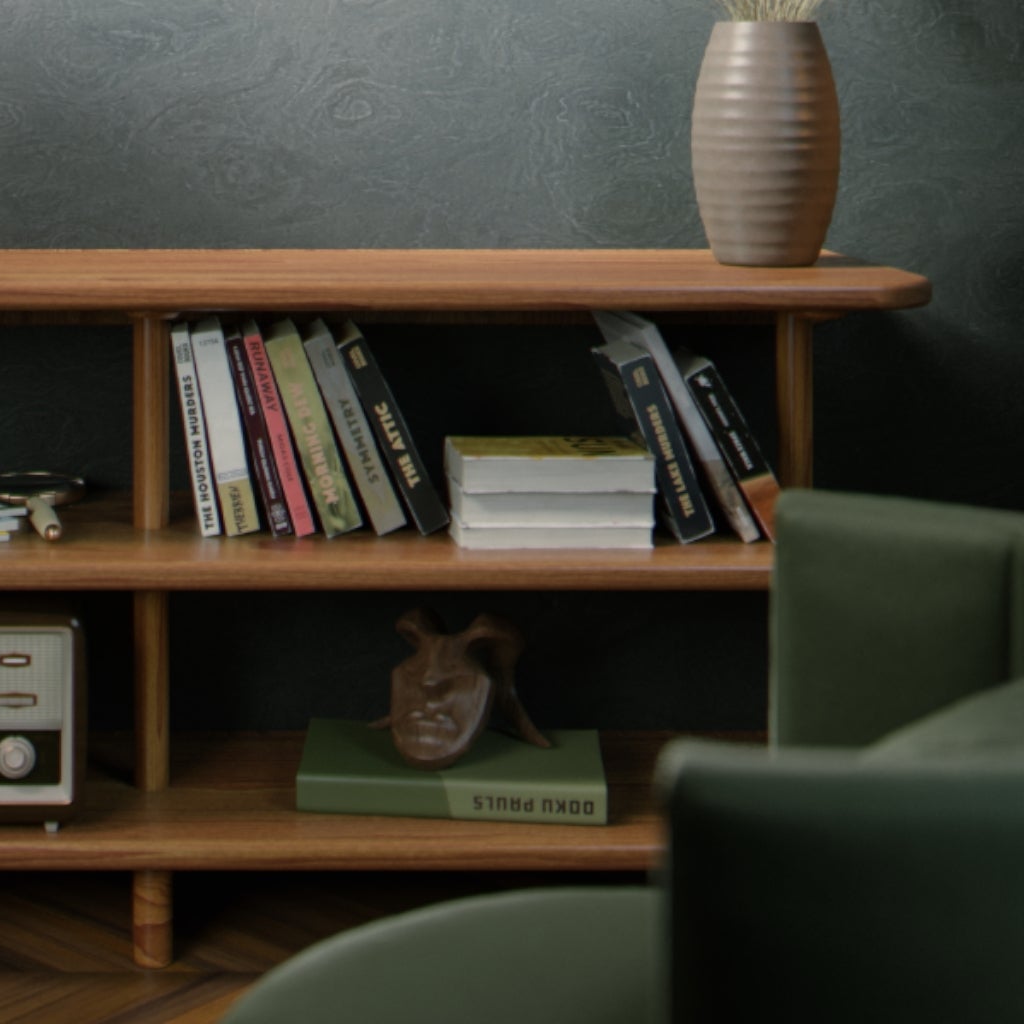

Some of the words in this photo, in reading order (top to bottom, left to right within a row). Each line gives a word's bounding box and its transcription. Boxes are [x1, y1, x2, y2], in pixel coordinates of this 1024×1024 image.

[249, 341, 278, 412] RUNAWAY
[289, 383, 312, 418] DEW
[182, 375, 200, 435] MURDERS
[374, 401, 406, 450] ATTIC
[339, 399, 380, 484] SYMMETRY
[646, 403, 675, 462] MURDERS
[192, 440, 211, 502] HOUSTON
[303, 422, 339, 505] MORNING
[397, 453, 421, 489] THE
[201, 506, 215, 530] THE
[678, 492, 695, 519] THE
[473, 795, 534, 813] PAULS
[542, 798, 594, 815] DOKU
